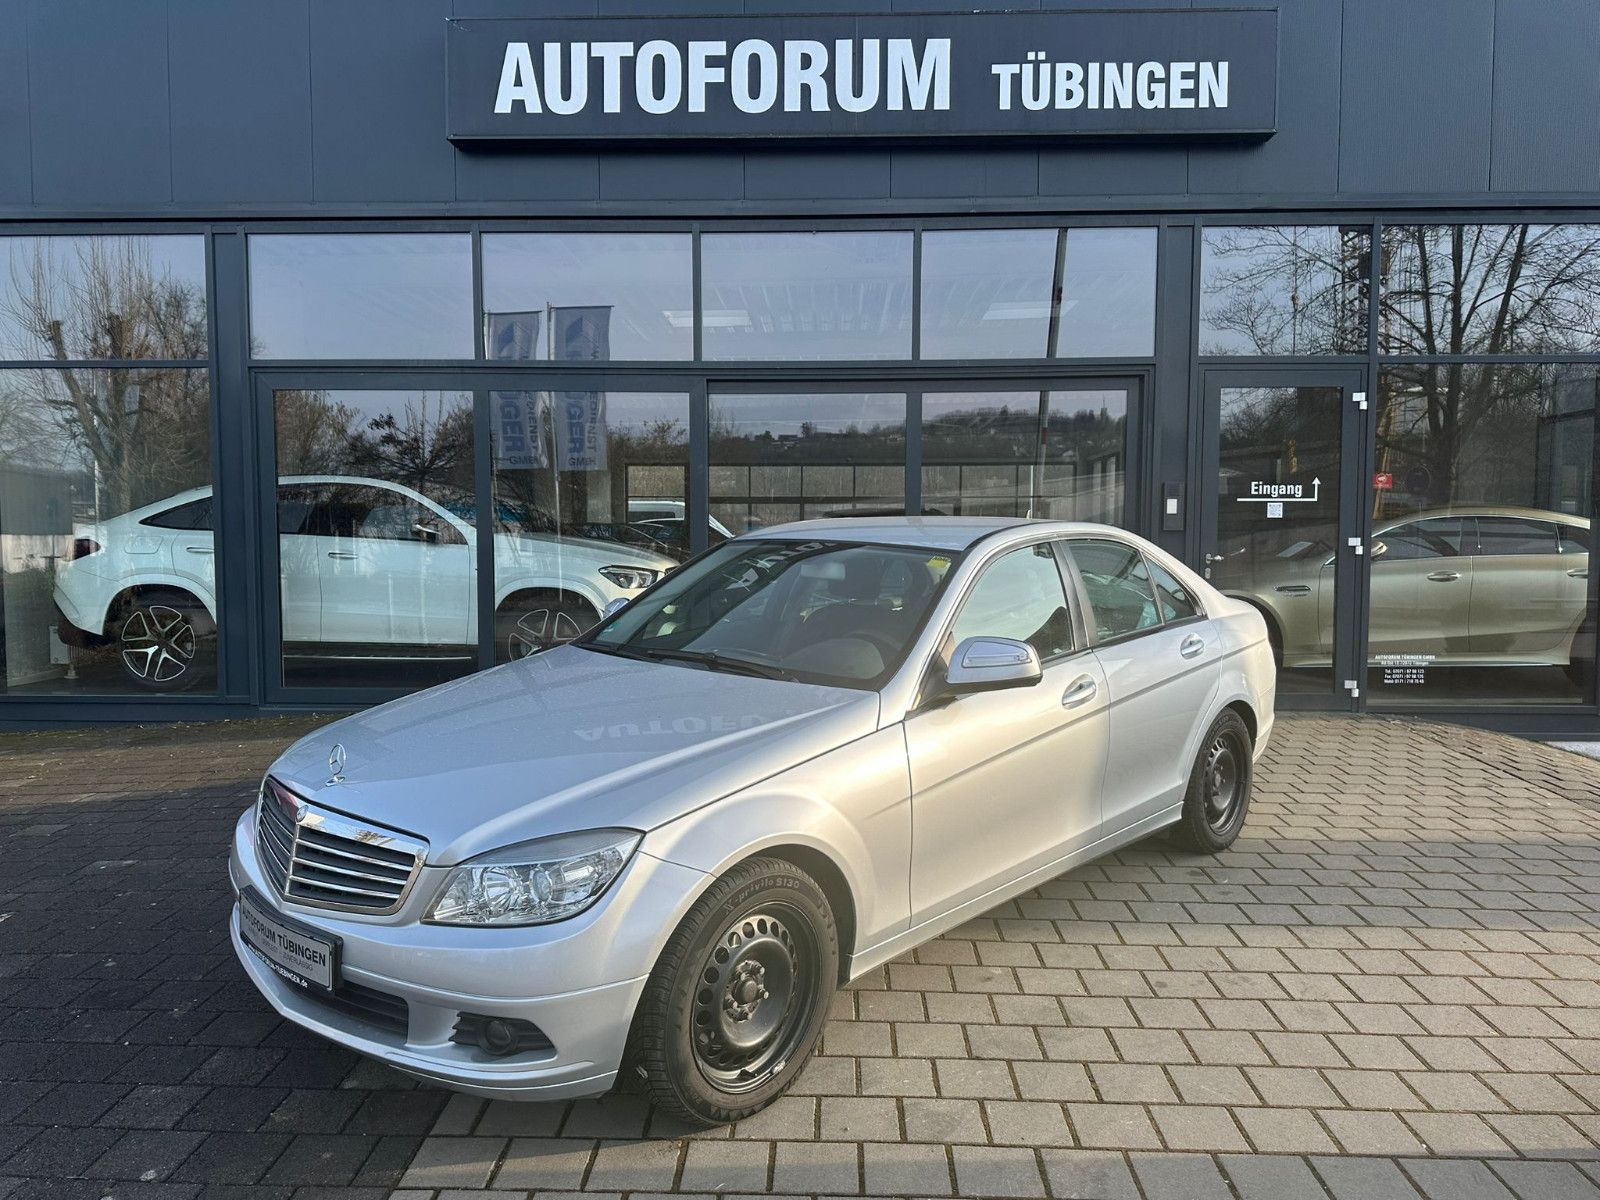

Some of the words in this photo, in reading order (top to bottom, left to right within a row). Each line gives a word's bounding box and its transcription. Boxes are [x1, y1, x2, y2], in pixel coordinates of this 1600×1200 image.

[494, 38, 951, 115] AUTOFORUM
[992, 52, 1229, 111] TÜBINGEN
[1251, 481, 1303, 498] Eingang
[277, 934, 327, 967] TÜBINGEN
